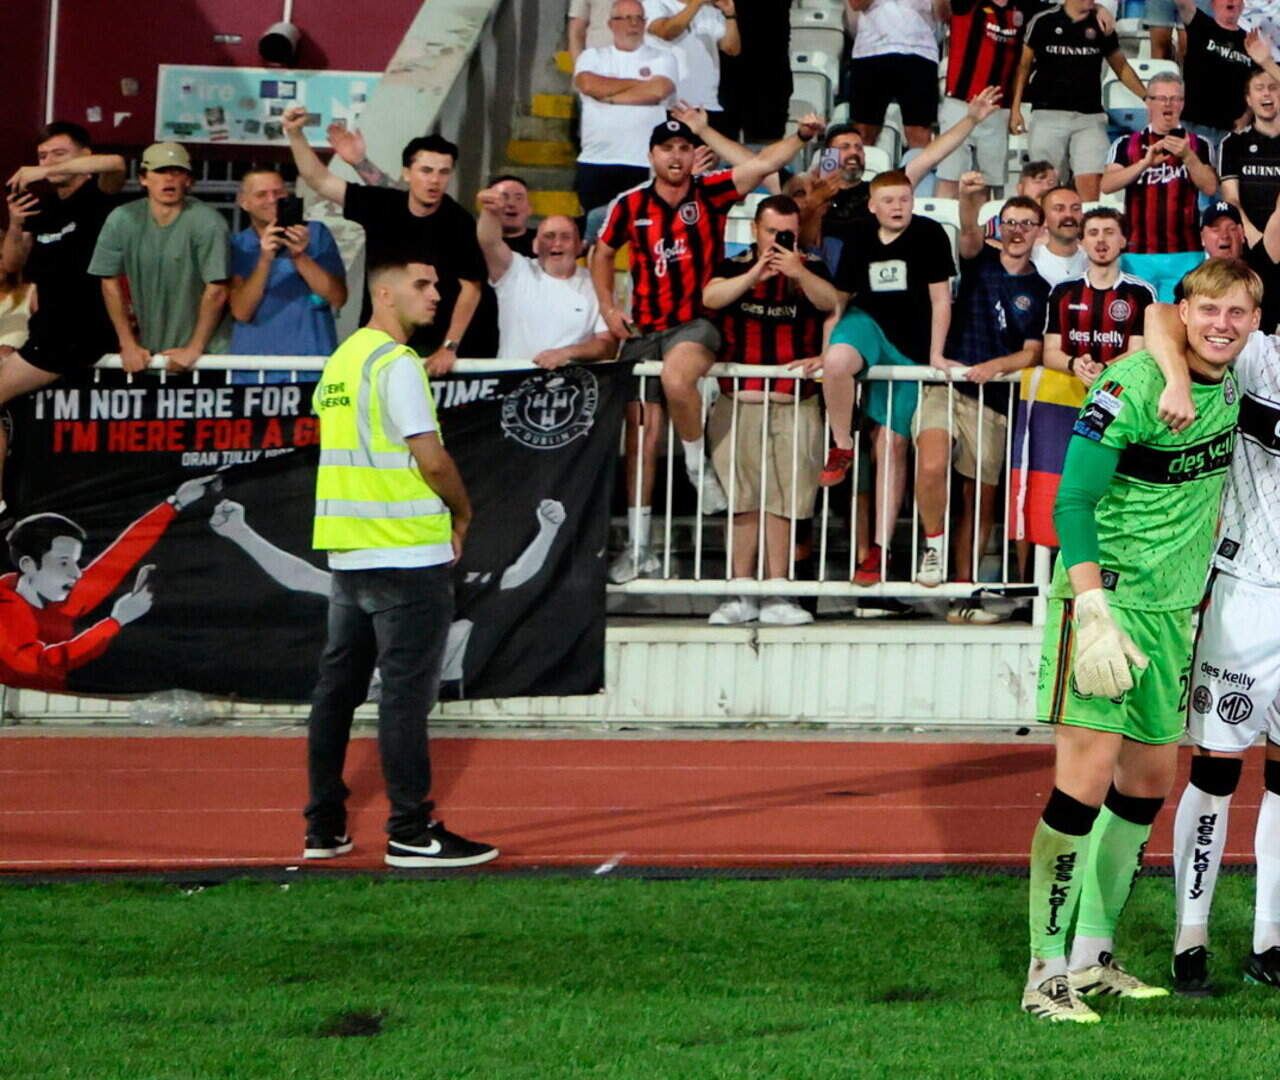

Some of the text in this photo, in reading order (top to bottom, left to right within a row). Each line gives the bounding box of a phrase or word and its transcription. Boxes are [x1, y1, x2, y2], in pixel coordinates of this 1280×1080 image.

[1069, 328, 1125, 348] des kelly
[35, 389, 80, 421] I'M
[90, 389, 147, 420] NOT
[156, 387, 234, 420] HERE
[243, 386, 300, 417] FOR
[53, 421, 98, 453] I'M
[107, 420, 187, 453] HERE
[194, 419, 249, 451] FOR
[261, 418, 284, 449] A
[1168, 450, 1206, 475] des
[1208, 431, 1233, 462] kell
[182, 452, 218, 467] ORAN
[221, 449, 261, 466] TULLY
[1201, 661, 1256, 689] des kelly
[1219, 696, 1252, 722] MG
[1188, 813, 1218, 900] des kelly
[1046, 851, 1077, 936] des kelly
